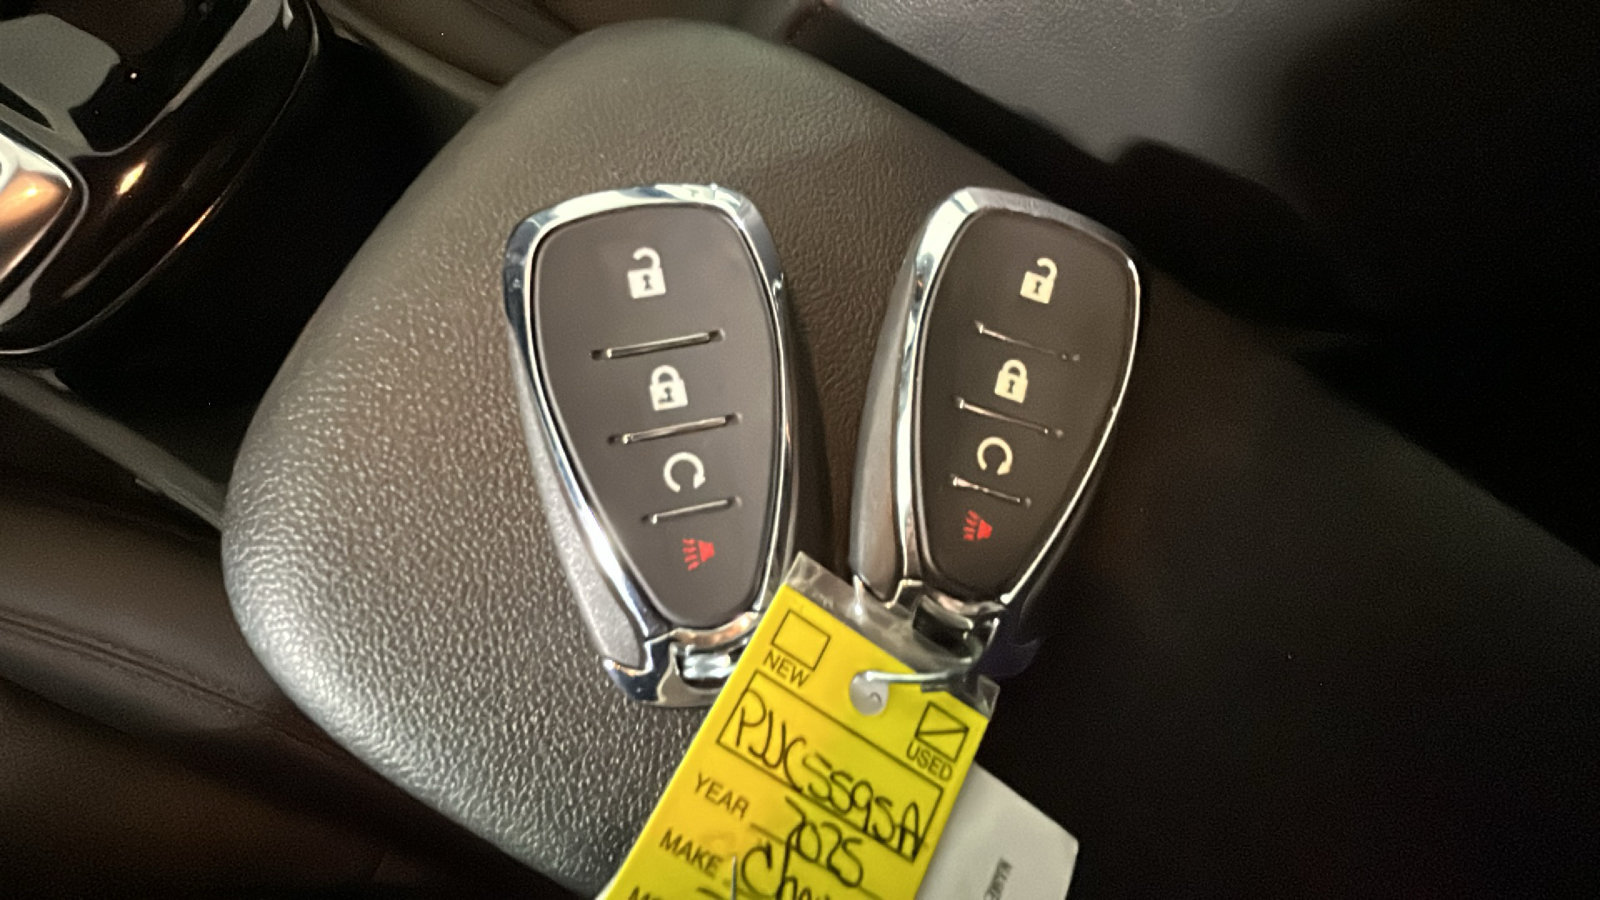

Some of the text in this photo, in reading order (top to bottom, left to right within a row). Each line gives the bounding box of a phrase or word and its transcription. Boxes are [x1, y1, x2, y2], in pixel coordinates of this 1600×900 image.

[762, 650, 810, 688] NEW
[906, 740, 953, 782] USED
[694, 771, 750, 819] YEAR
[659, 827, 723, 879] MAKE
